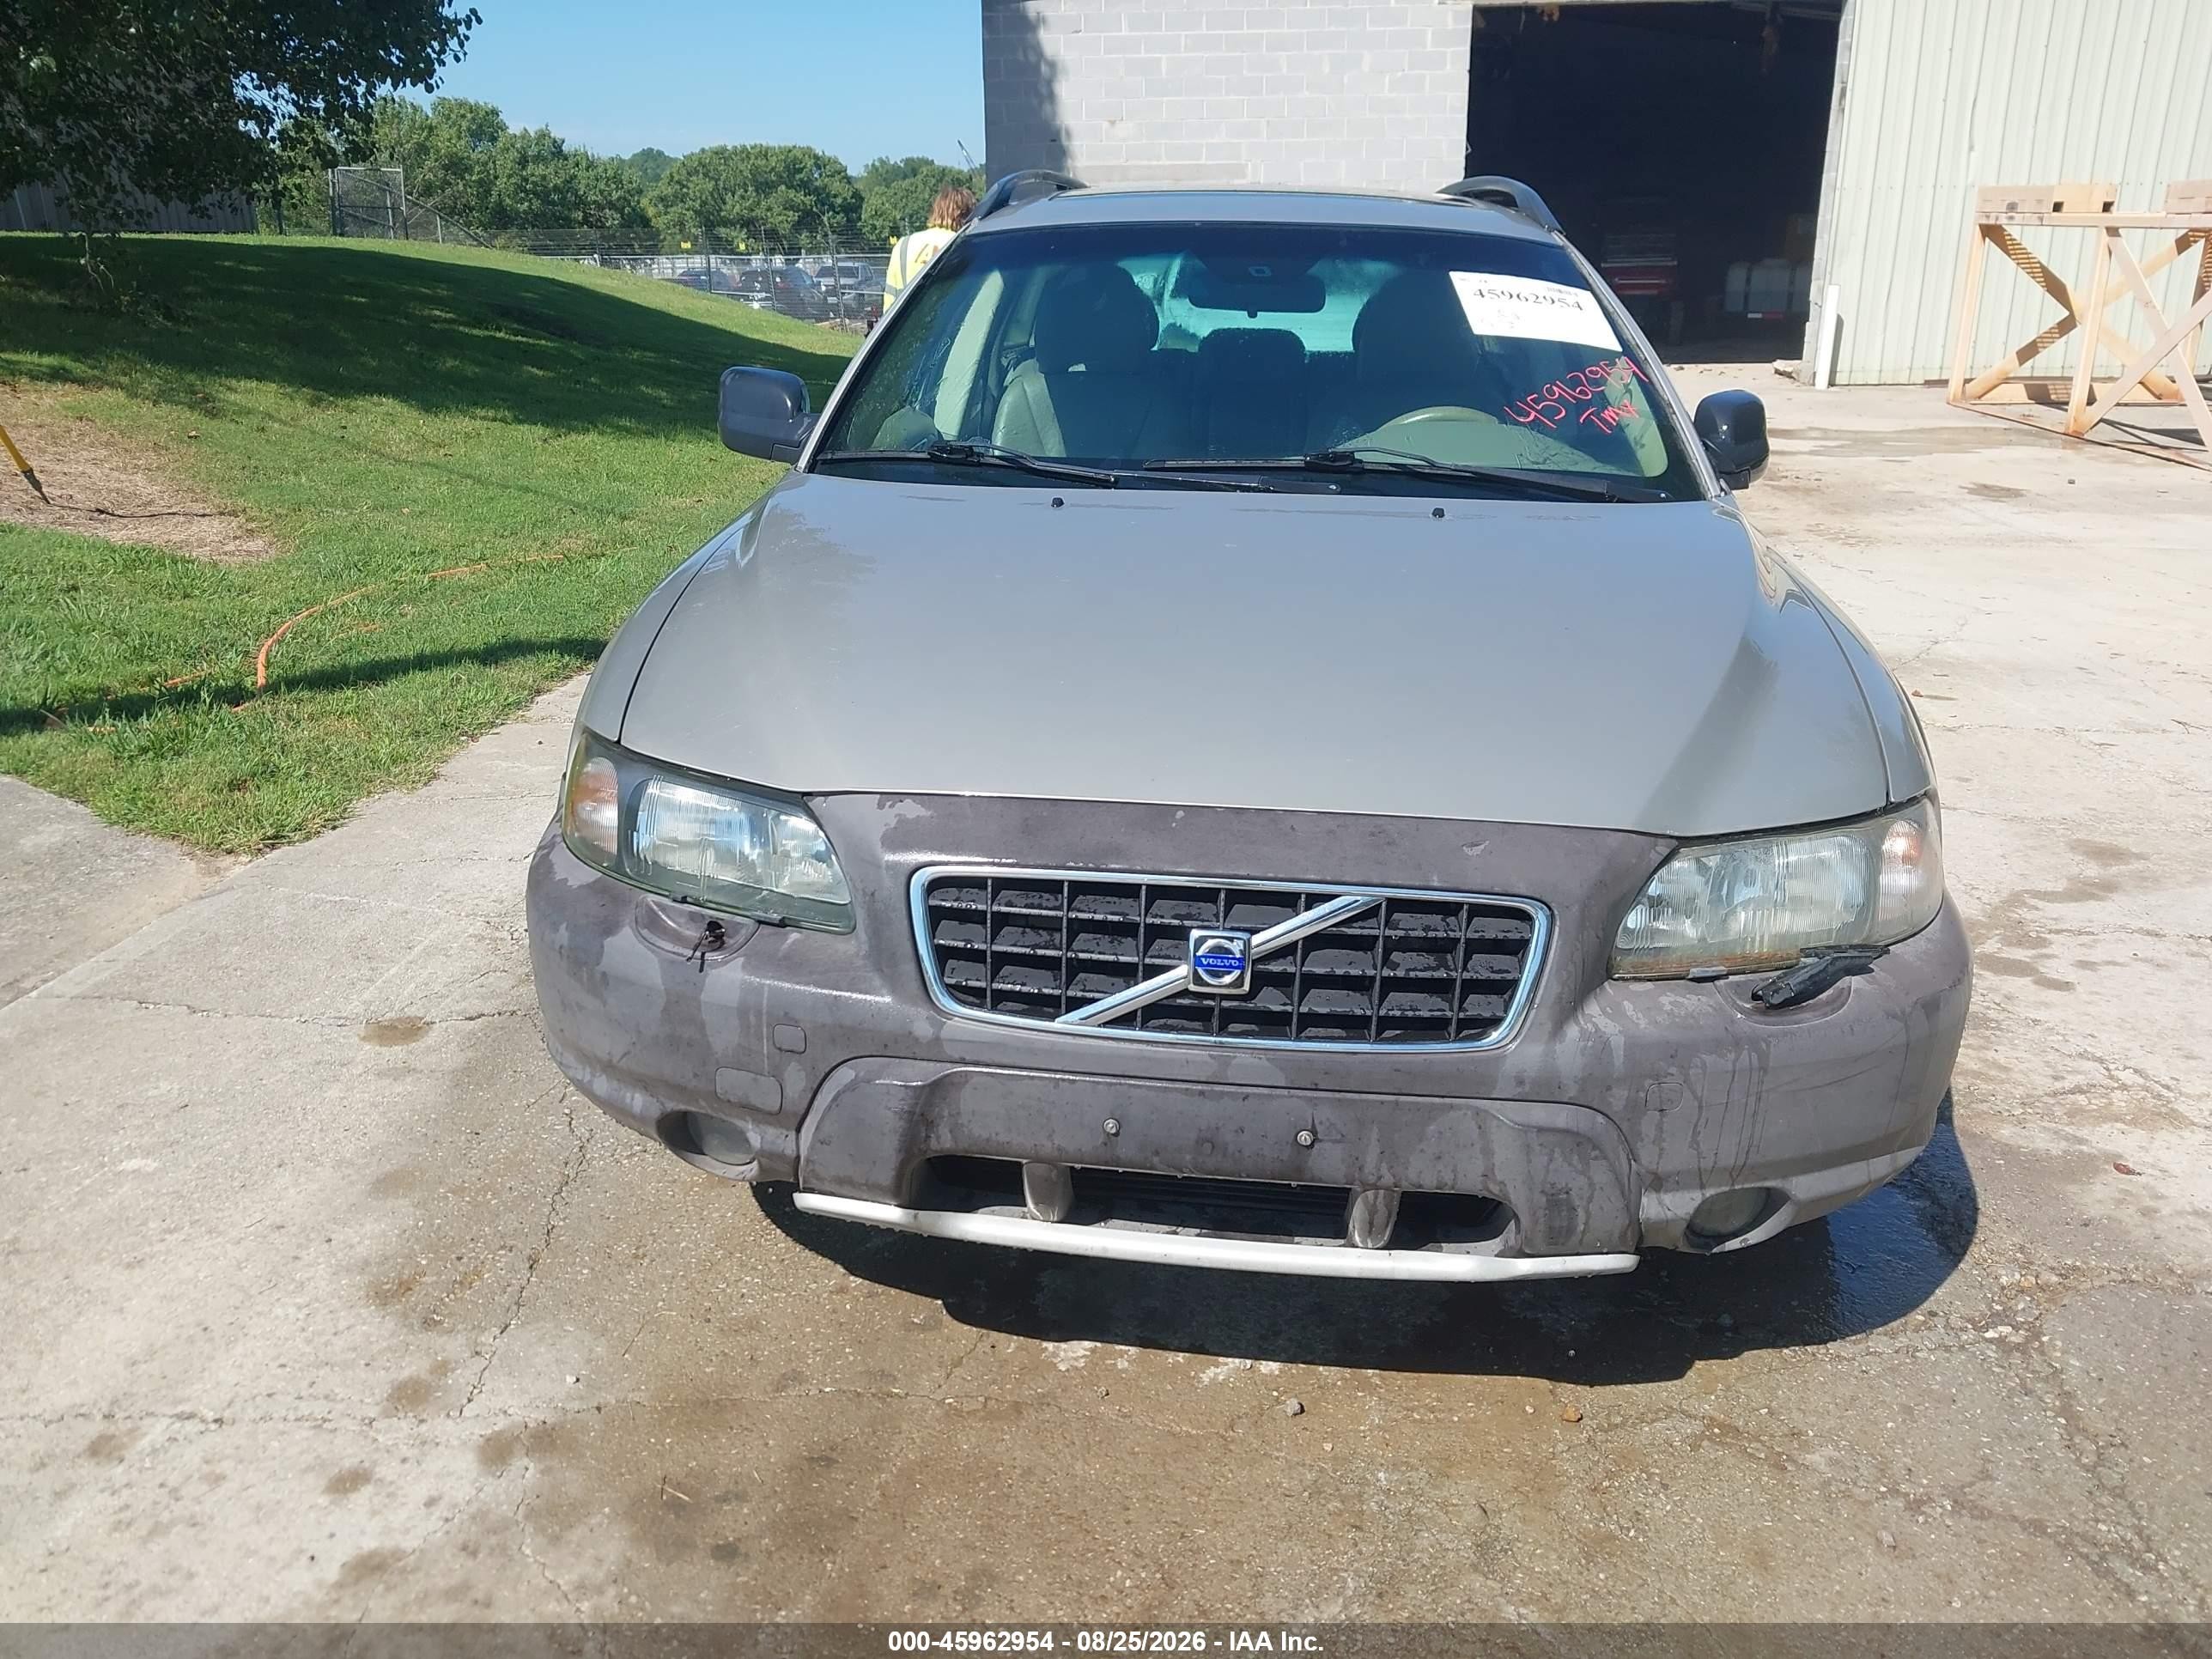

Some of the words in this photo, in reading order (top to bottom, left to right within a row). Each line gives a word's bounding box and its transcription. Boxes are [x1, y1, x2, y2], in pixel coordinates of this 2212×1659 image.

[1473, 289, 1583, 311] 45962954
[1504, 356, 1649, 428] 45962954
[1200, 957, 1240, 967] VOLVO
